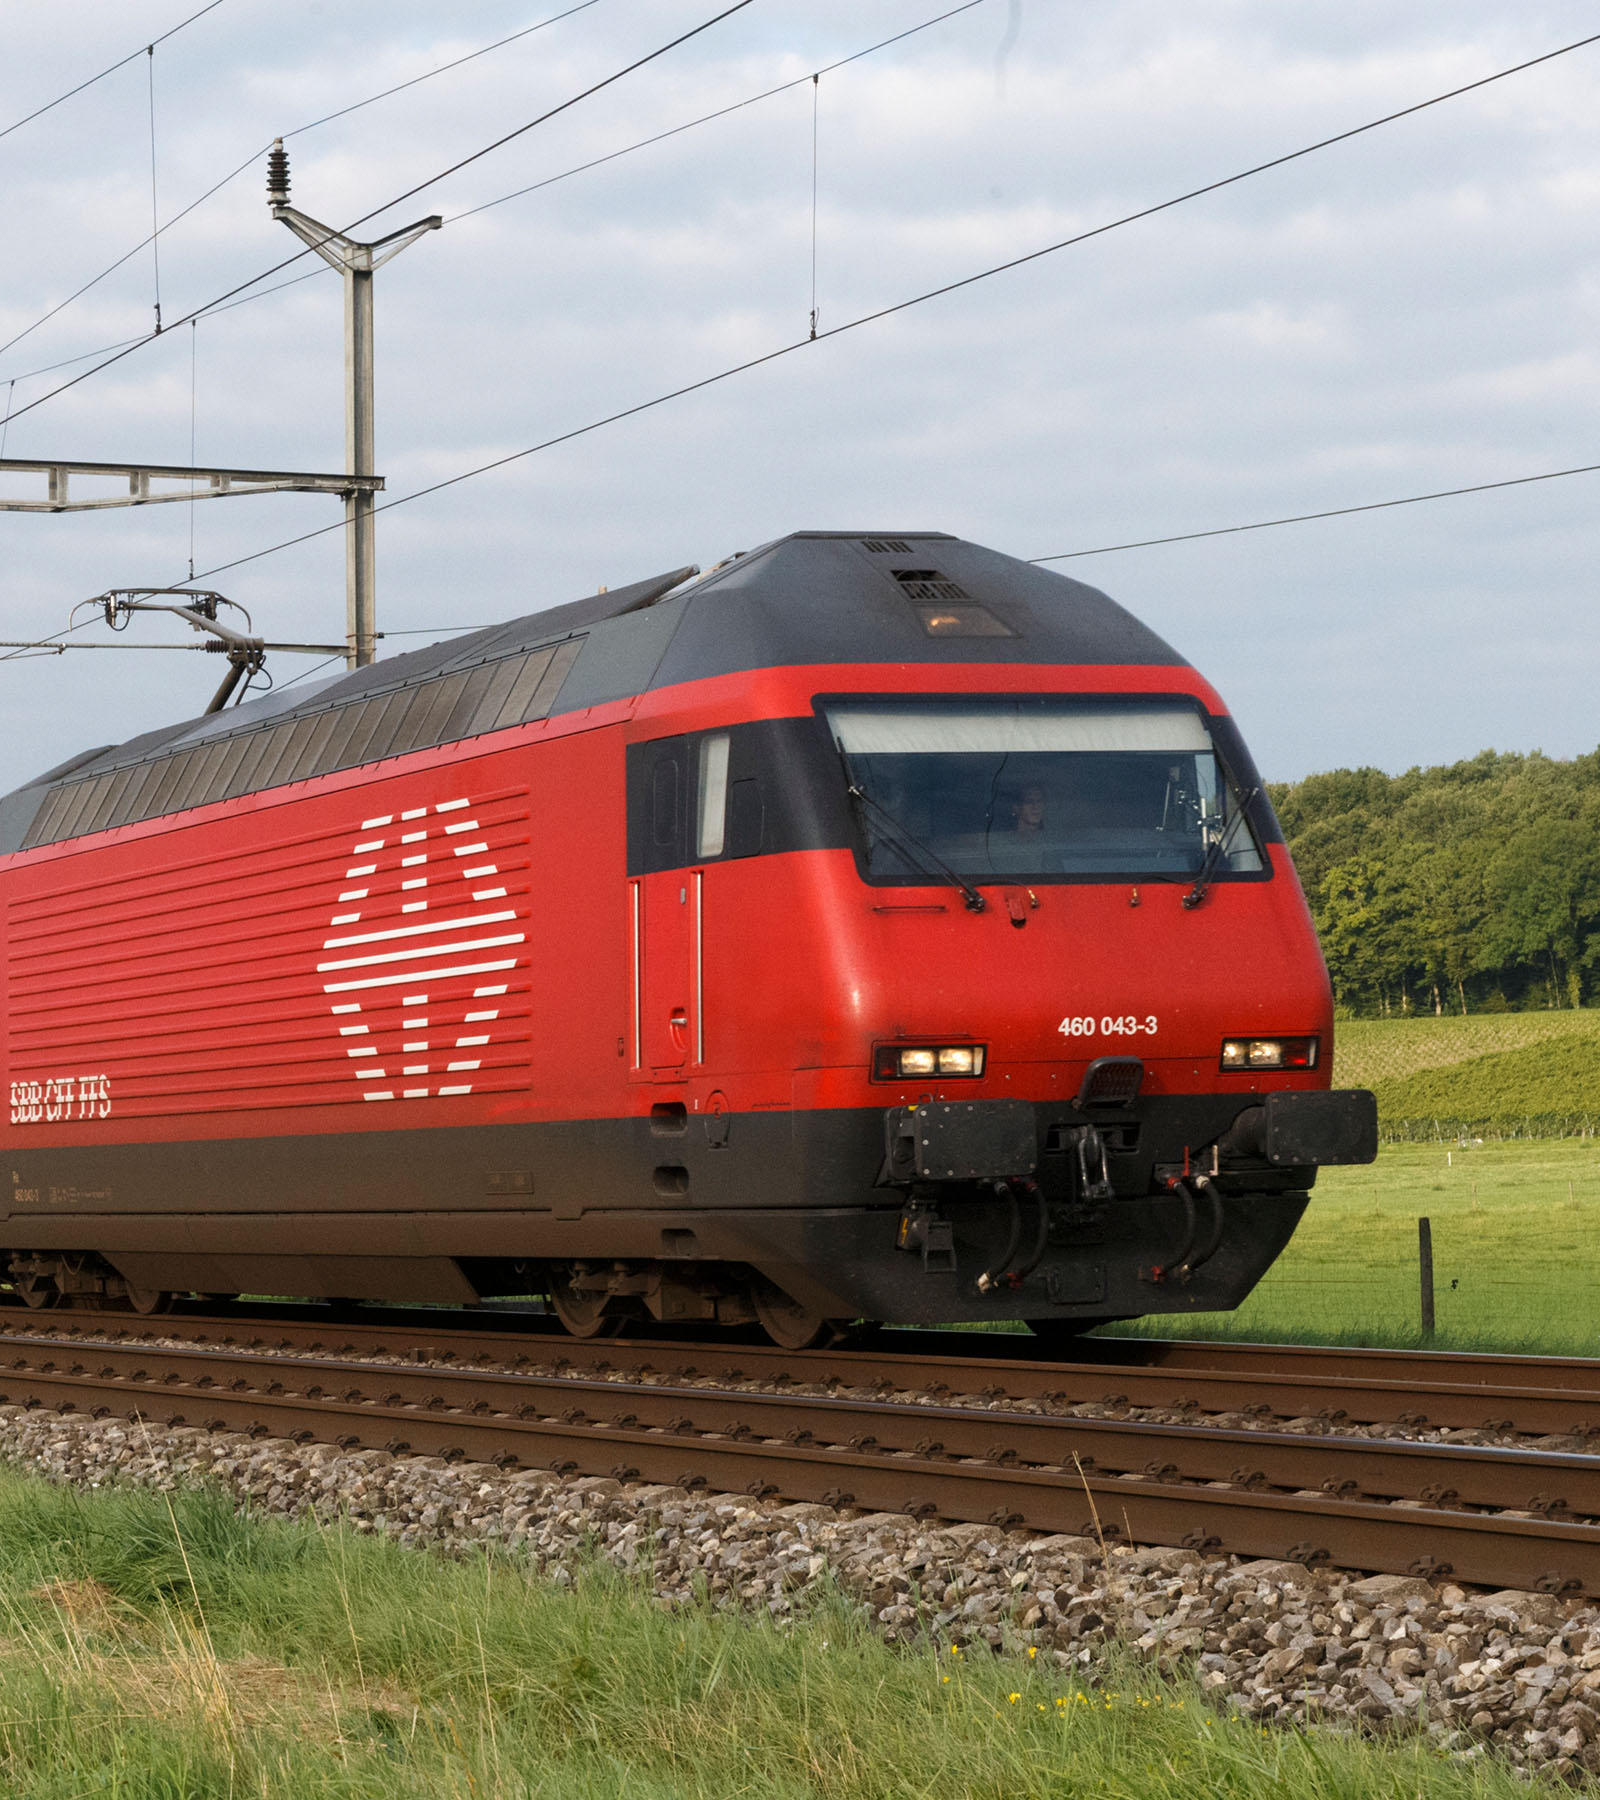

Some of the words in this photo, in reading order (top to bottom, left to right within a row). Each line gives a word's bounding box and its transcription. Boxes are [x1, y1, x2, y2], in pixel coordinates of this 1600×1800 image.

[1057, 1016, 1096, 1037] 460
[1100, 1015, 1159, 1035] 043-3
[10, 1081, 43, 1124] SBB
[43, 1078, 76, 1122] CFF
[78, 1074, 112, 1119] FFS
